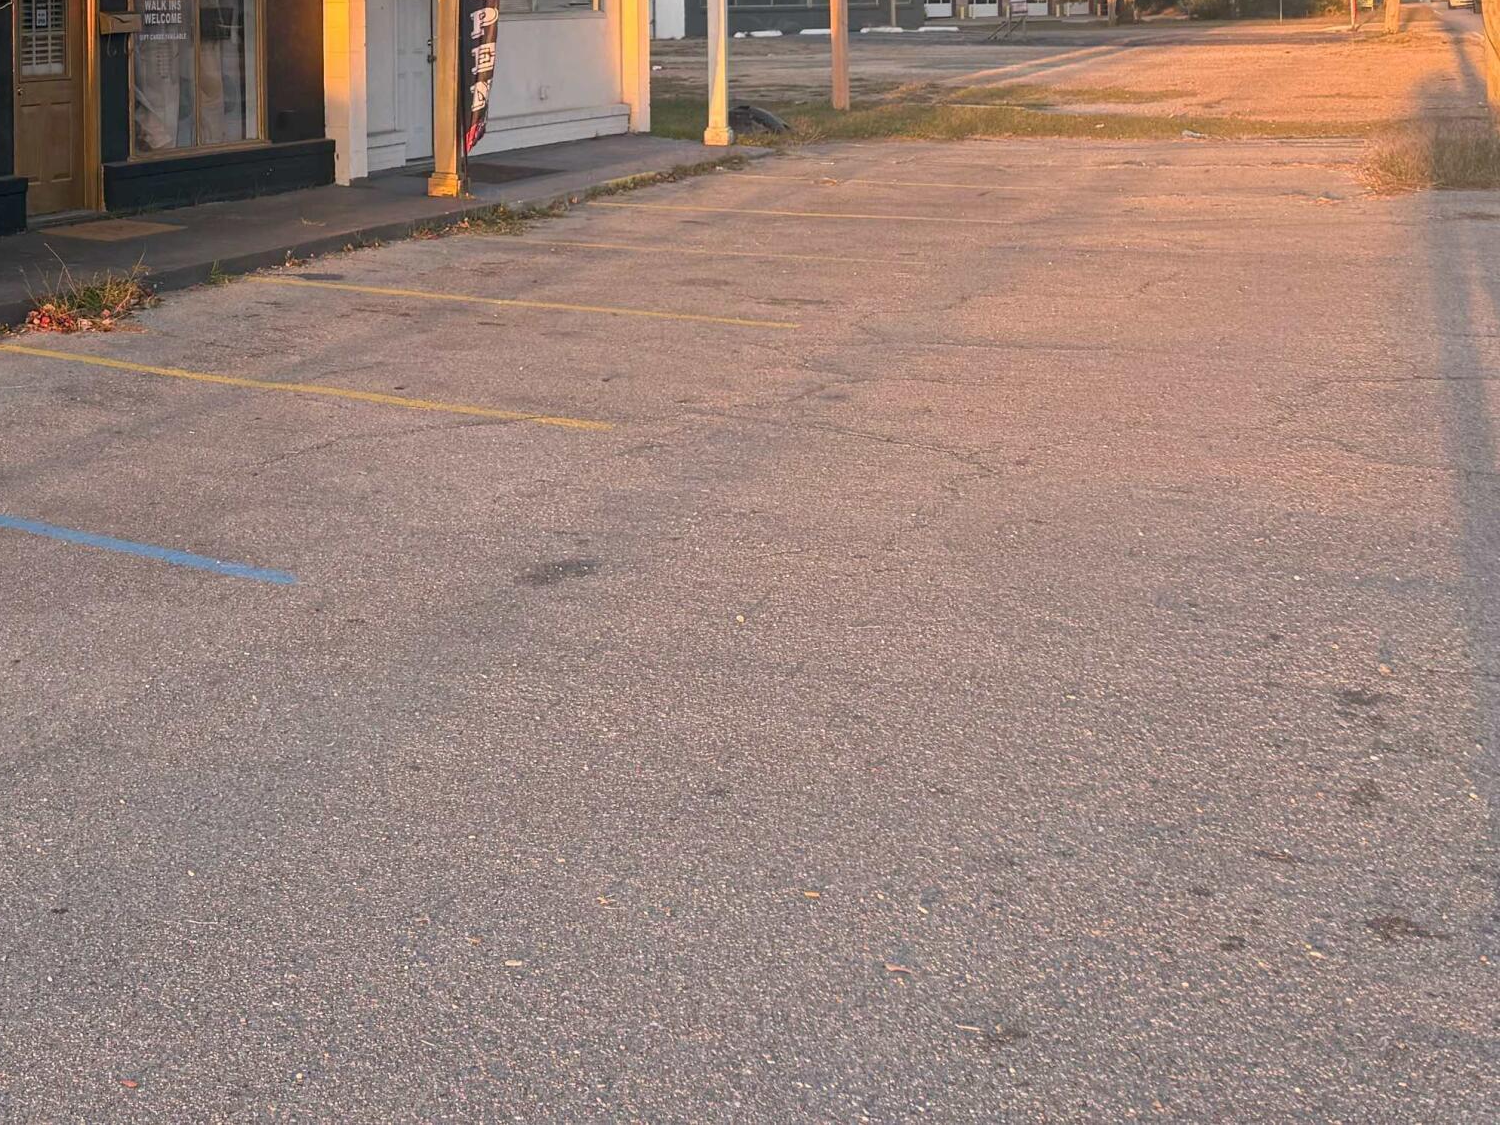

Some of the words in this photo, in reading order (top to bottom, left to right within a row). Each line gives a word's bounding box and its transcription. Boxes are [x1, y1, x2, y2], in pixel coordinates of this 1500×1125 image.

[144, 0, 167, 11] WALK
[169, 0, 182, 11] INS
[144, 13, 182, 24] WELCOME
